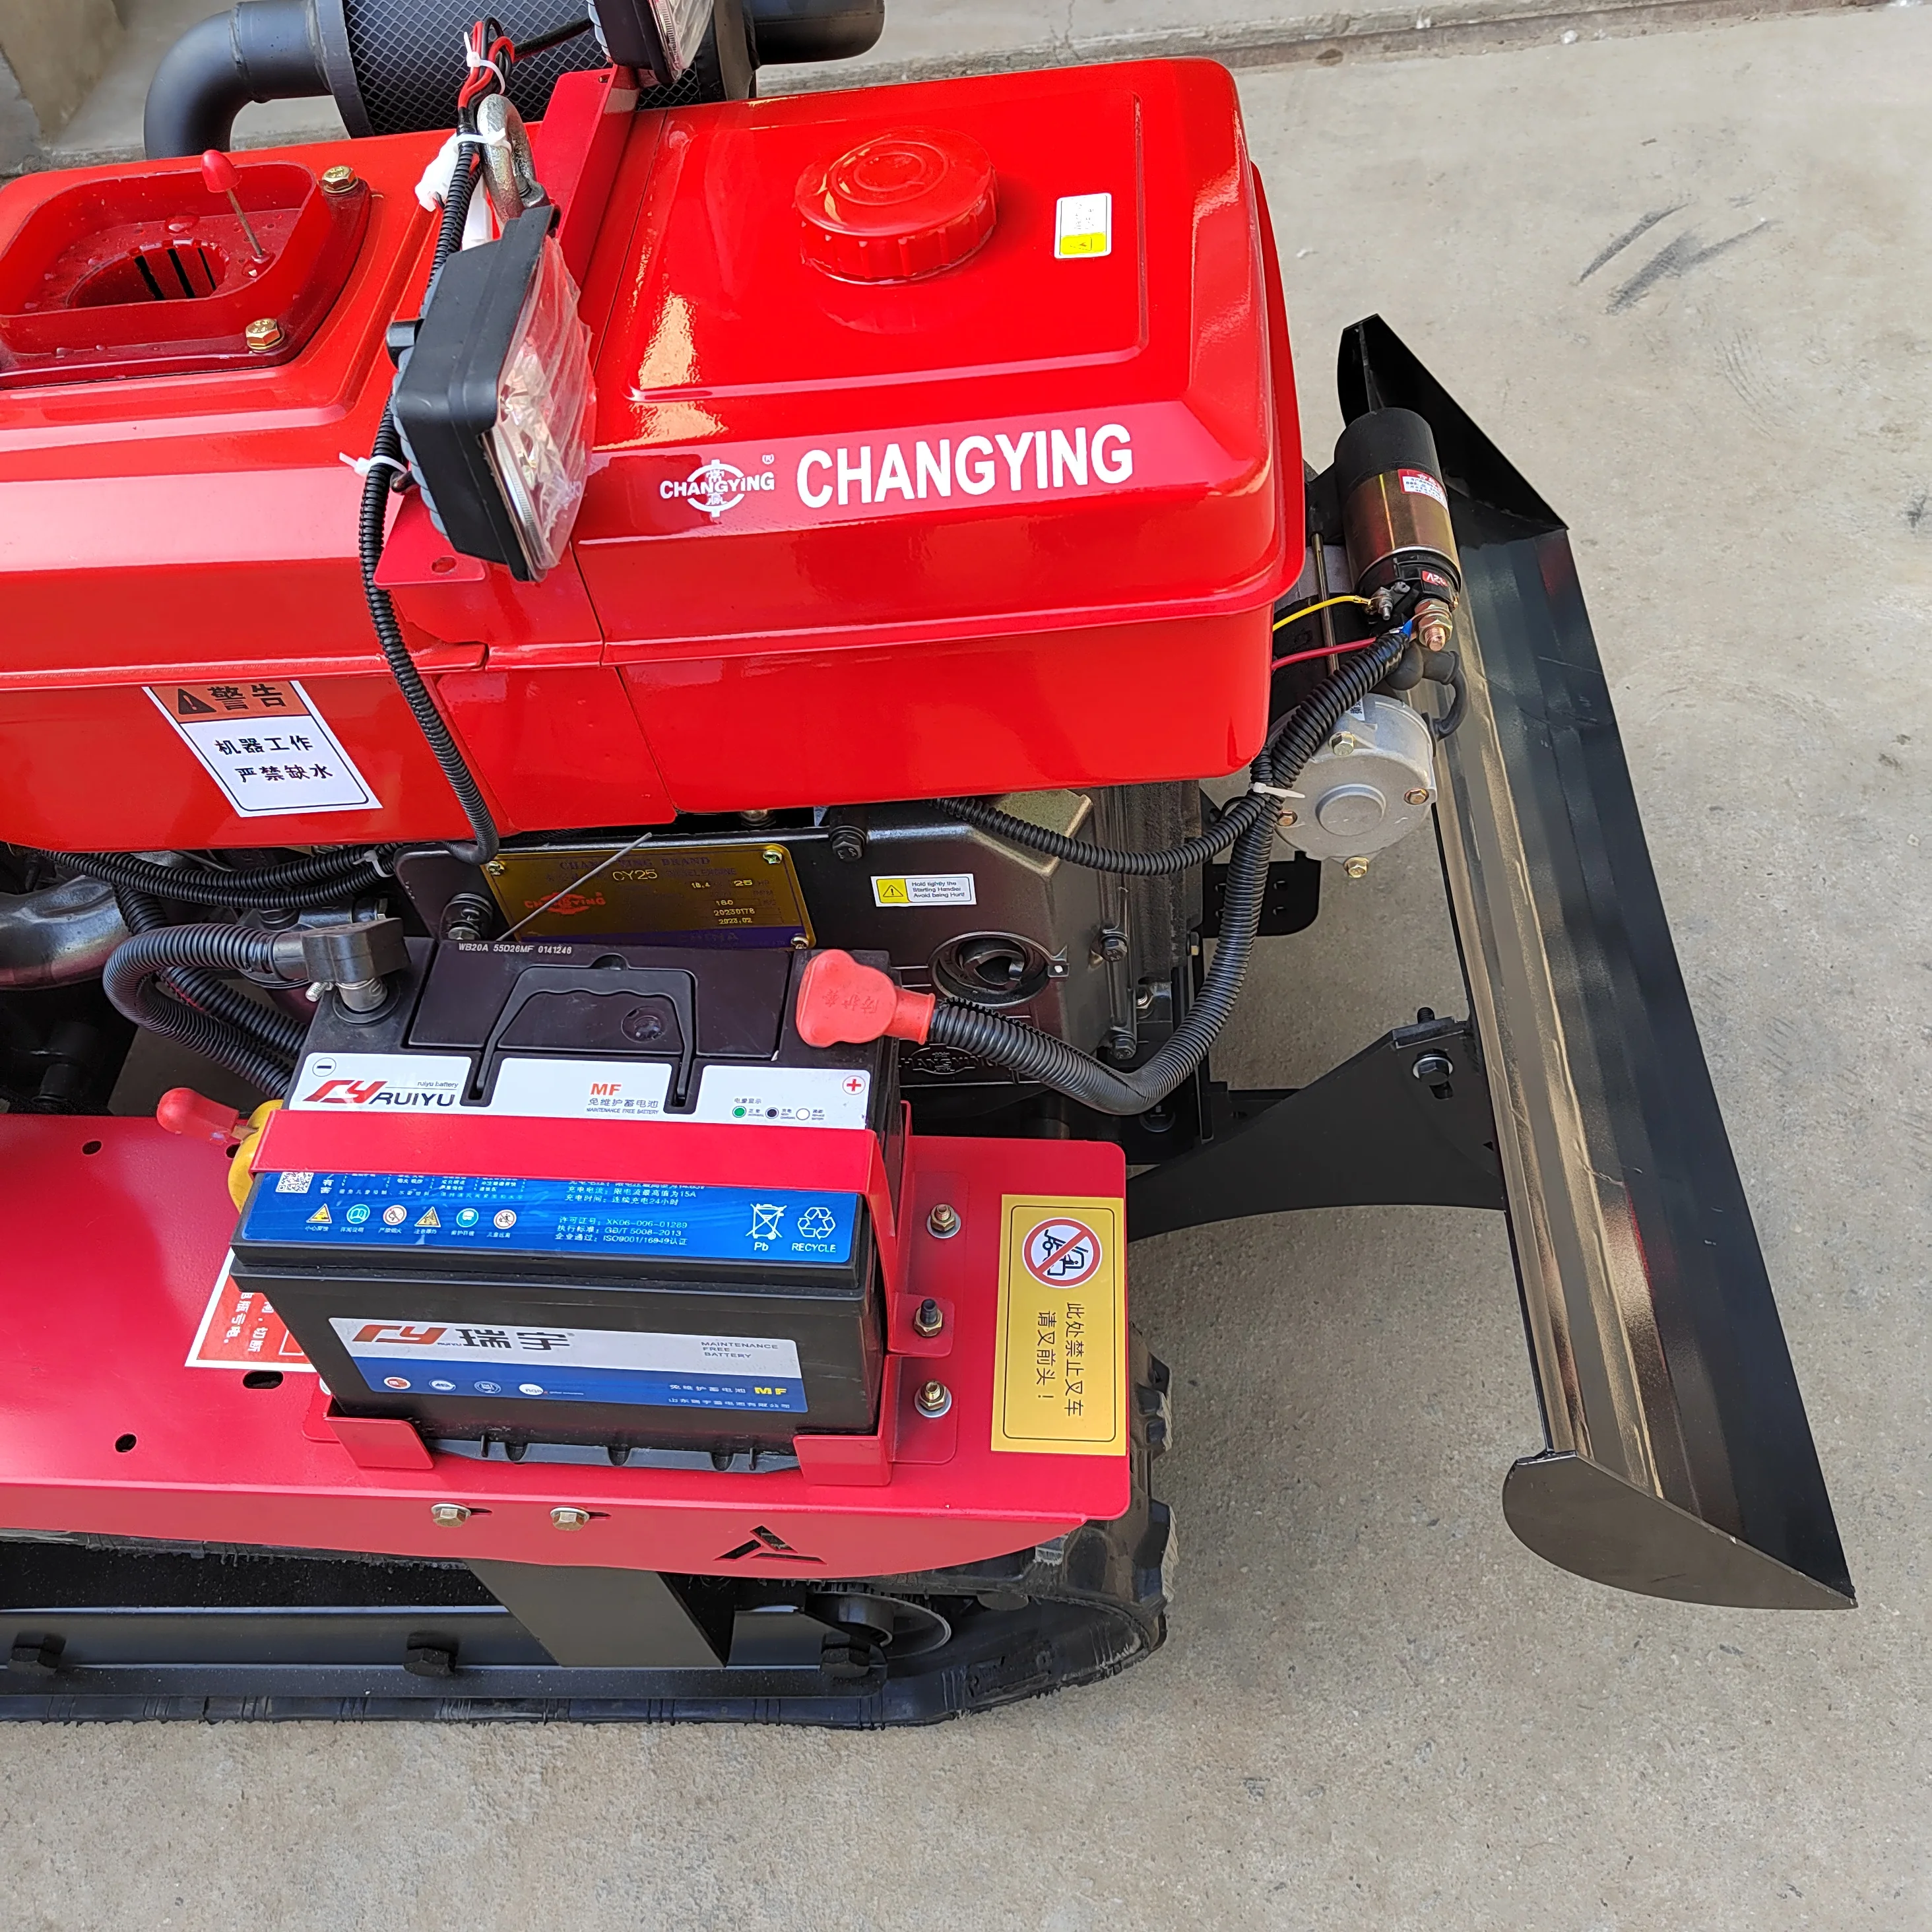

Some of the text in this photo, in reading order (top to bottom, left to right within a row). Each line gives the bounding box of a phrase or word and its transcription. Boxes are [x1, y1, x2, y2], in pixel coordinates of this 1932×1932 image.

[797, 424, 1133, 508] CHANGYING
[660, 472, 775, 499] CHANGYING
[207, 684, 287, 711] 警告
[215, 735, 313, 755] 机器工作
[235, 763, 333, 783] 严禁缺水
[560, 858, 653, 870] CHANYING
[612, 869, 658, 881] CY25
[459, 943, 572, 954] WB20A 55D26MF 0141246
[591, 1083, 622, 1095] MF
[368, 1092, 455, 1107] RUIYU
[588, 1098, 659, 1108] 免维护蓄电池
[754, 1241, 769, 1251] Pb
[792, 1242, 836, 1252] RECYCLE
[455, 1328, 570, 1351] 瑞宇
[1064, 1301, 1085, 1417] 此处禁止叉车
[670, 1384, 746, 1394] 免维护蓄电池
